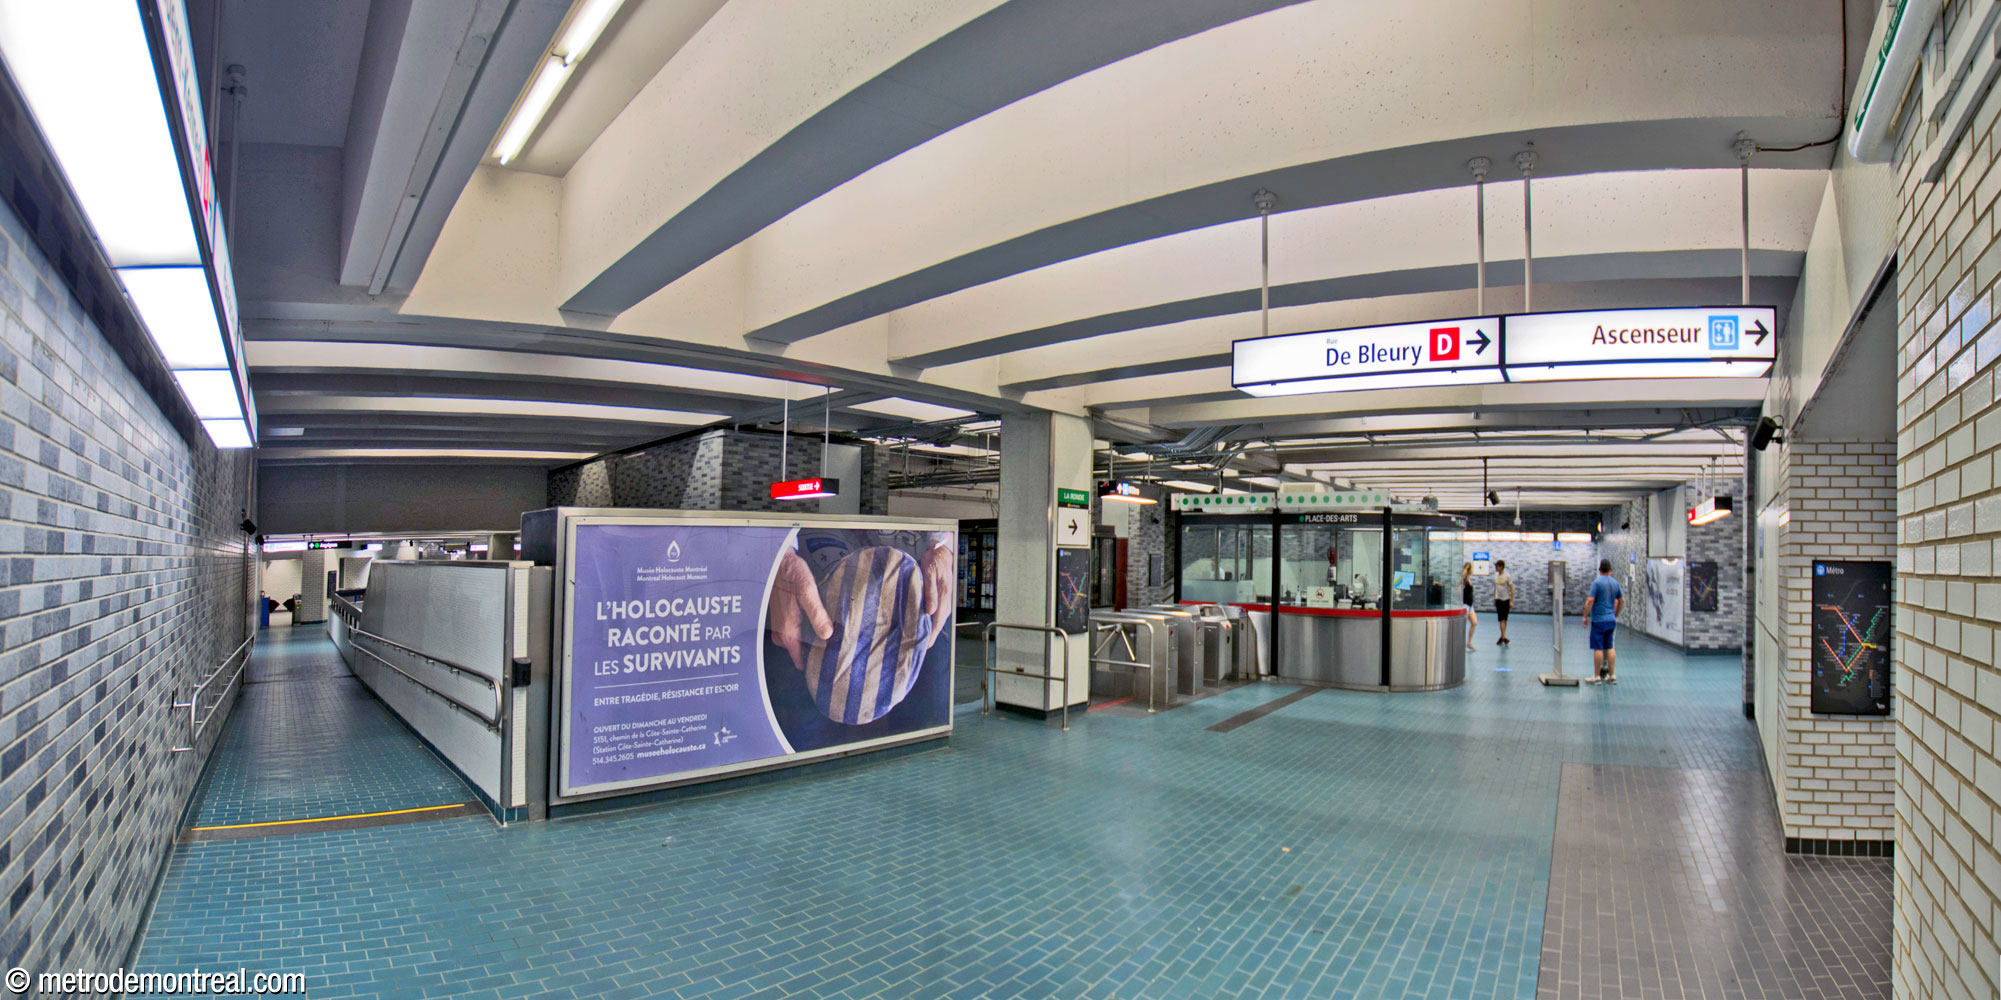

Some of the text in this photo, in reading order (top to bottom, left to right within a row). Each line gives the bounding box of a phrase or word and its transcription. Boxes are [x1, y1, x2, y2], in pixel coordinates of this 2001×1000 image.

[1592, 325, 1701, 345] Ascenseur
[1326, 333, 1453, 366] De Bleury D
[1305, 514, 1358, 523] PLACE-DES-ARTS
[1825, 565, 1845, 575] Métro
[608, 618, 731, 647] RACONTÉ PAR
[594, 646, 741, 676] LES SURVIVANTS
[594, 696, 620, 707] ENTRE
[621, 692, 661, 704] TRAGÉDIE,
[661, 688, 704, 700] RÉSISTANCE
[705, 686, 714, 695] ET
[593, 713, 708, 733] OUVERT DU DIMANCHE AU VENDREDI
[593, 735, 609, 744] 5151,
[609, 734, 631, 743] chemin
[631, 731, 639, 739] de
[592, 745, 617, 754] (Station
[592, 743, 706, 765] 514.345.2605 museeholocauste.ca
